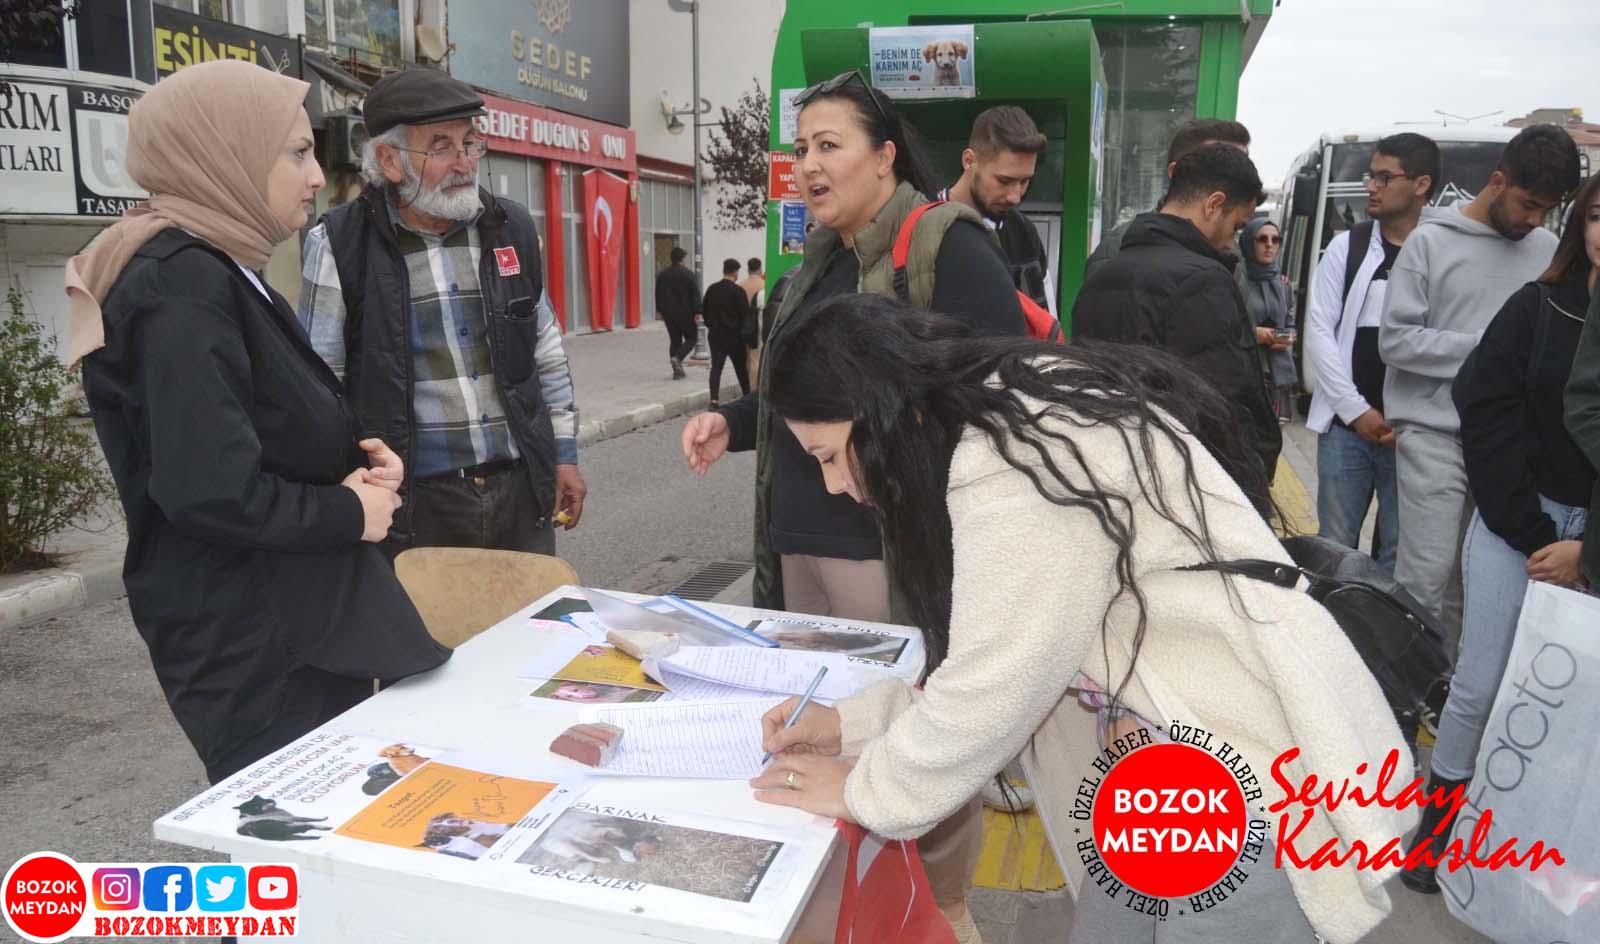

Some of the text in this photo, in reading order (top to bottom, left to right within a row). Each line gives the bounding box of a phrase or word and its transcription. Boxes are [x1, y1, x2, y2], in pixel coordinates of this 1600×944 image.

[511, 30, 592, 81] SEDEF
[911, 48, 922, 60] DE
[876, 61, 909, 73] KARNIM
[81, 90, 137, 112] BAŞO
[479, 106, 529, 142] SEDEF
[228, 778, 250, 791] DE
